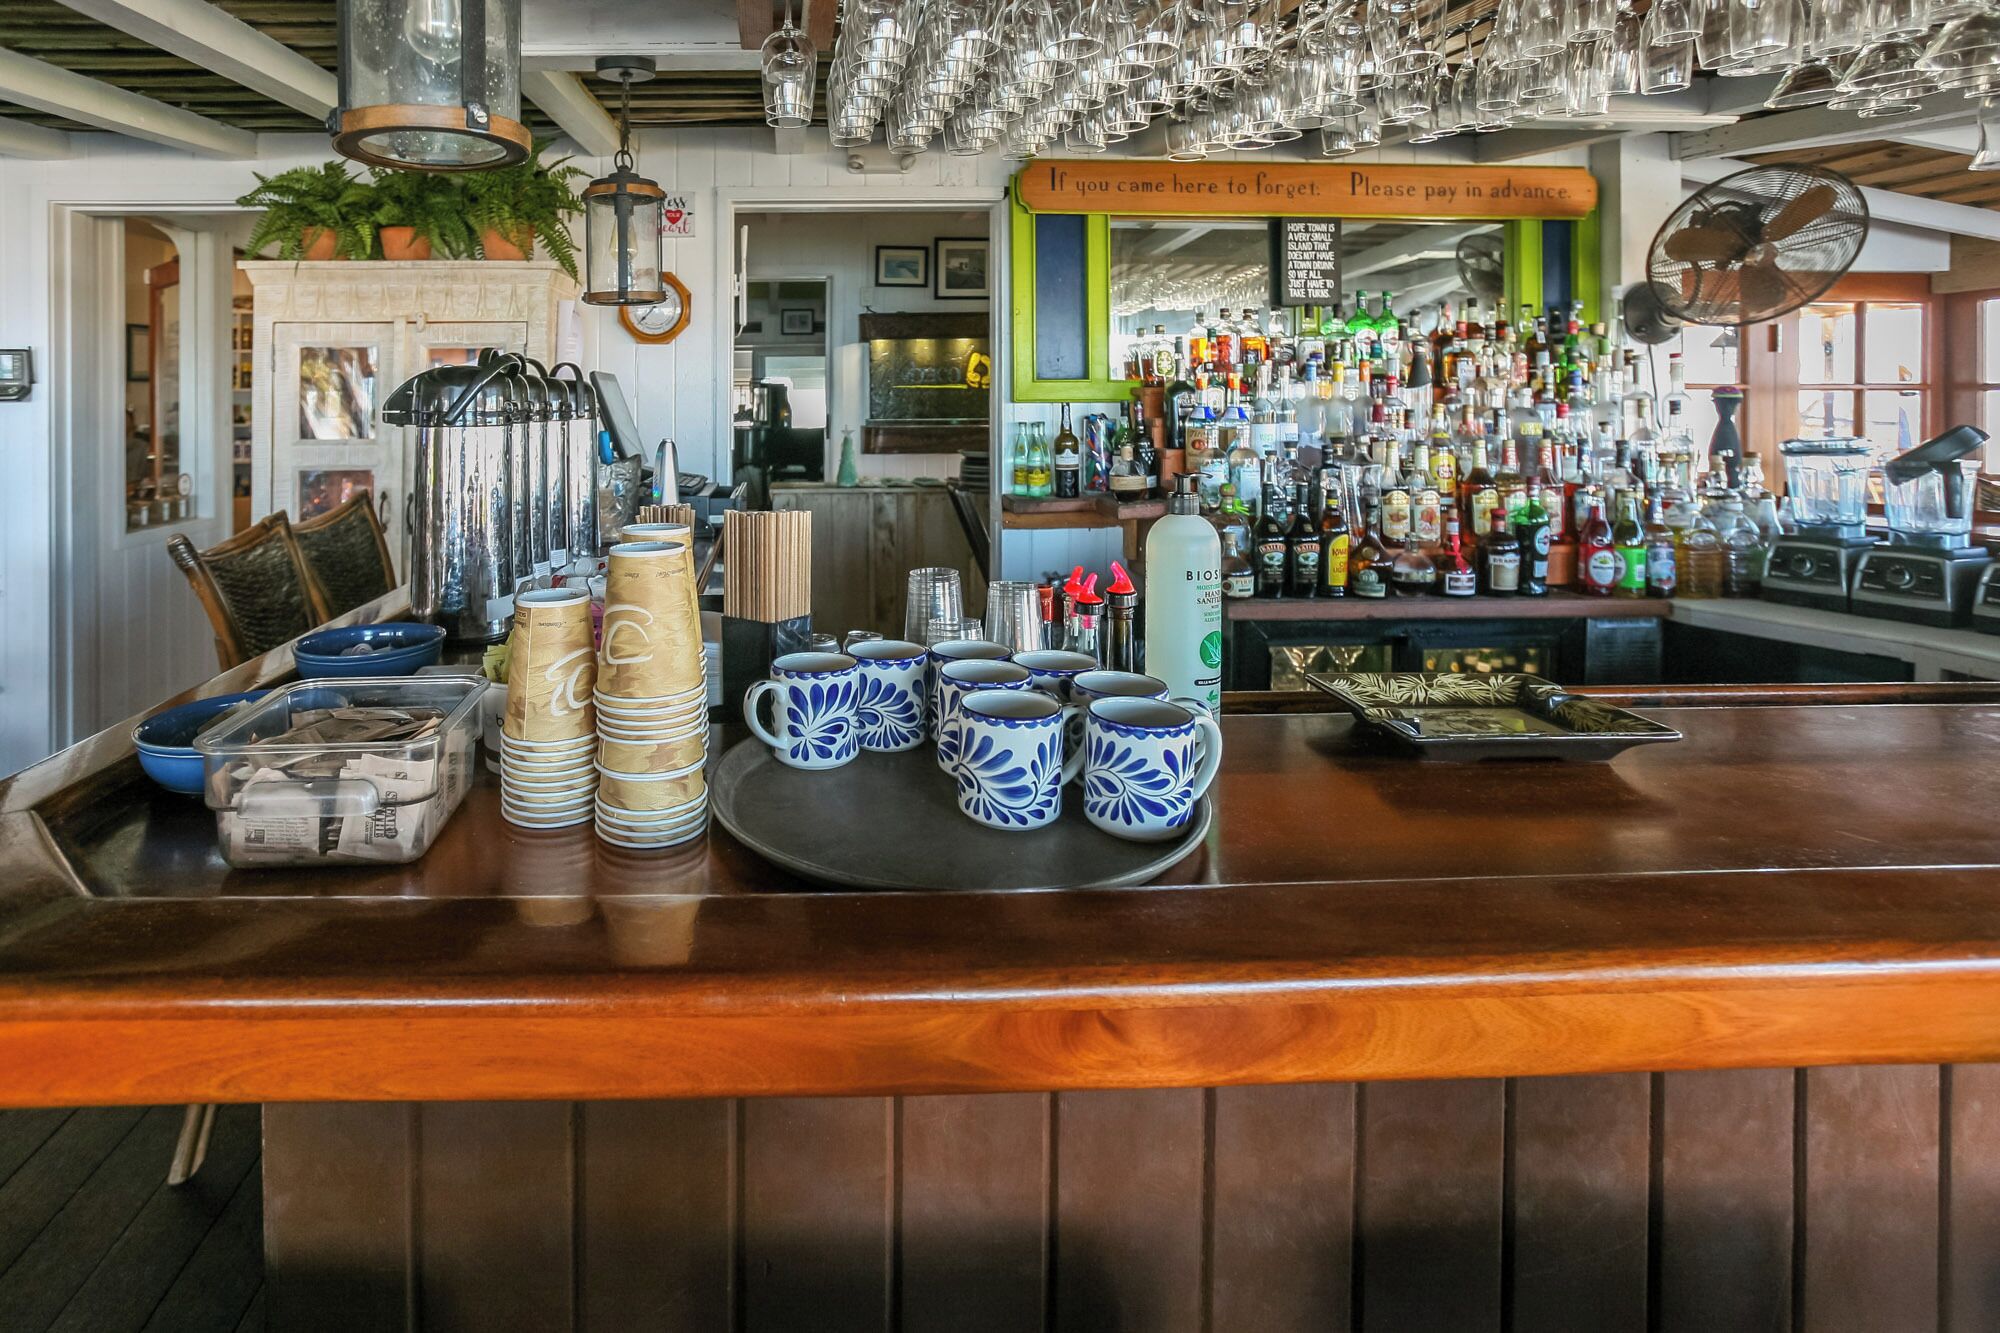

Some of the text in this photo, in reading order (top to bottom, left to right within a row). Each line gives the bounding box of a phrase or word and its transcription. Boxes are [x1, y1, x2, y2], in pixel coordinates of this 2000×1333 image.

[1050, 166, 1068, 192] If
[1076, 180, 1109, 197] you
[1117, 181, 1165, 194] came
[1172, 173, 1218, 194] here
[1228, 176, 1247, 194] to
[1351, 171, 1416, 197] Please
[1425, 184, 1458, 203] pay
[1466, 181, 1482, 198] in
[1490, 179, 1572, 200] advance.
[662, 196, 687, 210] ess
[661, 217, 690, 234] eart
[1287, 223, 1336, 233] HOPE TOWN IS
[1288, 232, 1334, 242] A VERY SMALL
[1288, 242, 1331, 251] ISLAND THAT
[1287, 251, 1335, 261] DOES NOT HAVE
[1288, 261, 1335, 270] A TOWN DRUNK
[1287, 270, 1323, 279] SO WE ALL
[1288, 279, 1335, 289] JUST HAVE TO
[1288, 288, 1307, 298] TAKE
[1186, 569, 1221, 581] BIOS
